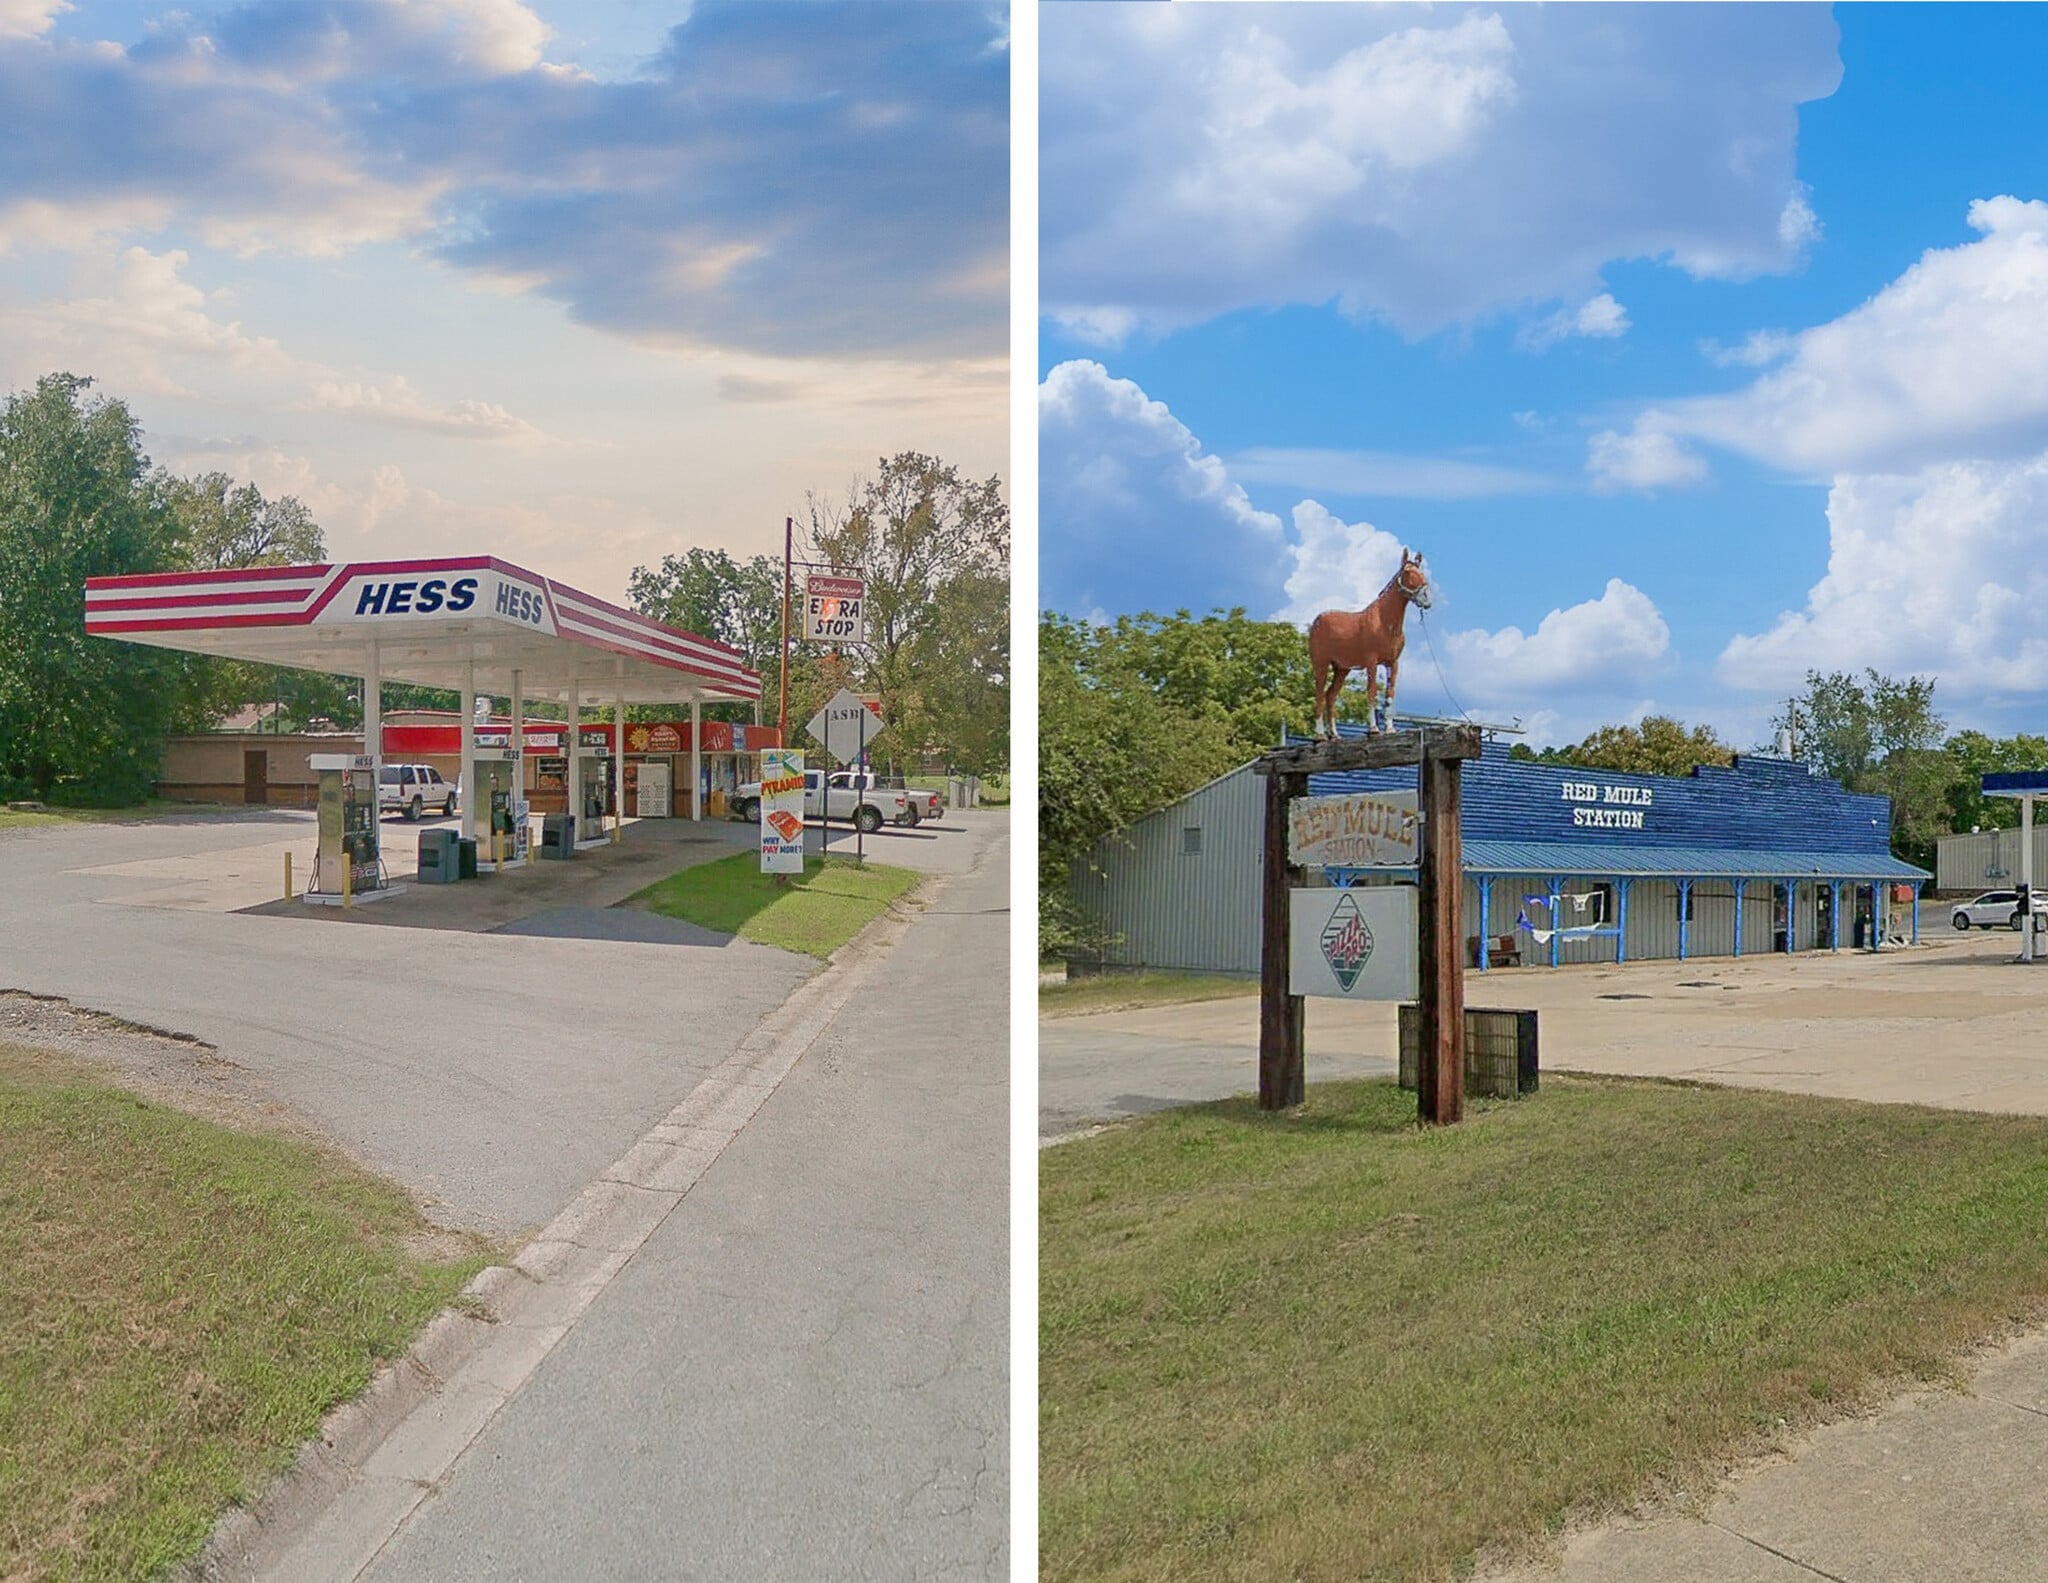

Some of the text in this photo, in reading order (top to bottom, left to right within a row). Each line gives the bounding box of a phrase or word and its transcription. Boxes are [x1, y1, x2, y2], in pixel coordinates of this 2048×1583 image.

[354, 578, 478, 616] HESS
[495, 581, 543, 625] HESS
[815, 619, 854, 636] STOP
[355, 755, 373, 767] HESS
[502, 749, 520, 760] HESS
[1560, 782, 1653, 806] RED MULE
[1573, 807, 1645, 829] STATION
